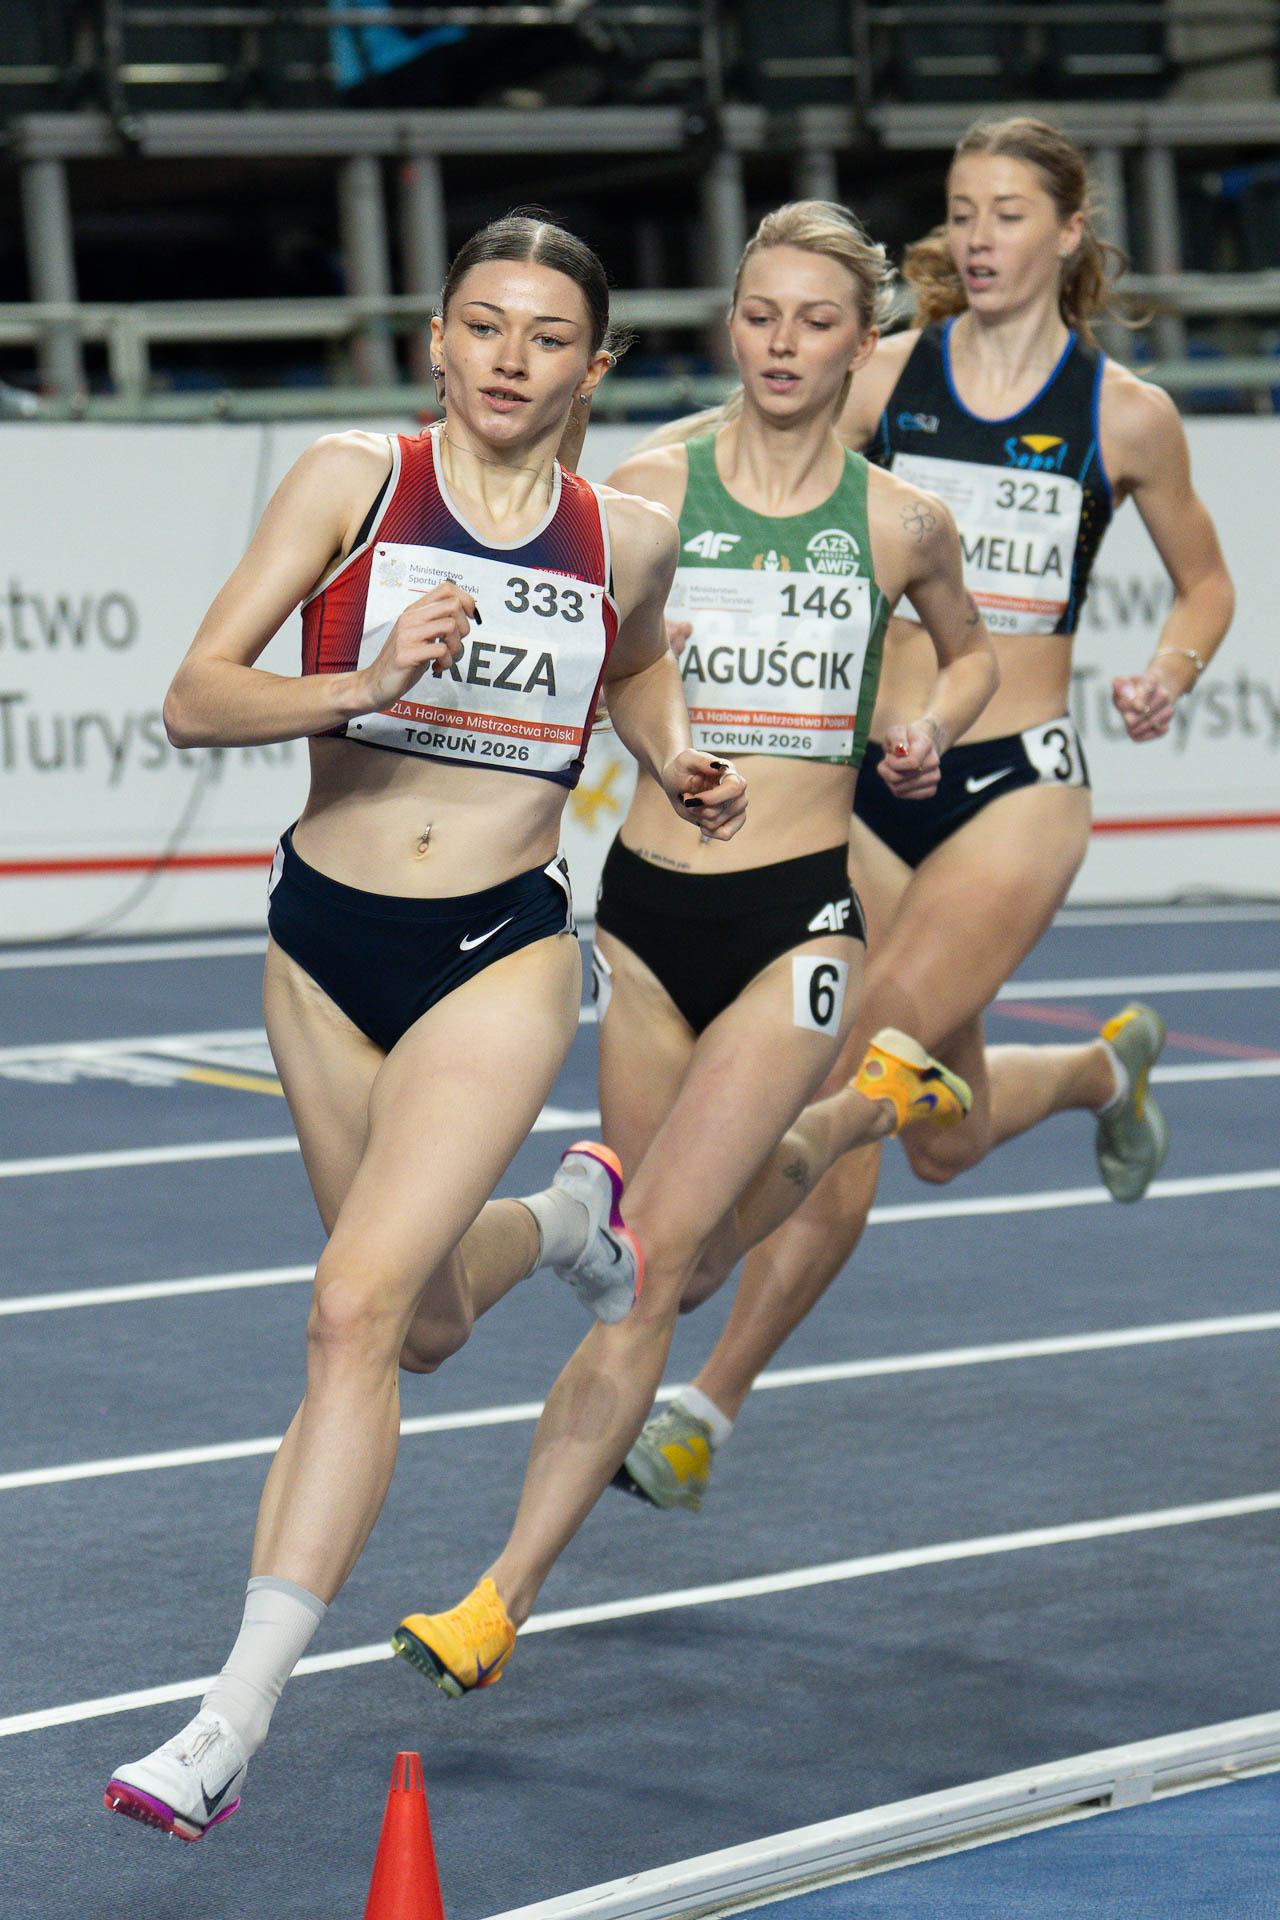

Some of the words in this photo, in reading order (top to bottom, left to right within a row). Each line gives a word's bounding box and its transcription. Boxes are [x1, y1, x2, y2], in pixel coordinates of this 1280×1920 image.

[996, 479, 1061, 515] 321
[684, 530, 742, 559] 4F
[815, 536, 849, 551] AZS
[960, 534, 1064, 578] MELLA
[408, 574, 436, 587] Sportu
[409, 564, 463, 580] Ministerstwo
[816, 558, 853, 574] AWF
[0, 577, 141, 653] two
[504, 577, 584, 623] 333
[780, 584, 852, 620] 146
[681, 641, 855, 690] AGUŚCIK
[415, 708, 463, 725] Halowe
[466, 717, 541, 737] Mistrzostwa
[544, 727, 575, 741] Polski
[707, 711, 750, 724] Halowe
[752, 714, 821, 728] Mistrzostwa
[405, 727, 477, 754] TORUŃ
[480, 741, 530, 761] 2026
[700, 730, 763, 746] TORUŃ
[768, 734, 812, 750] 2026
[1042, 727, 1073, 780] 3
[808, 899, 851, 932] 4F
[808, 964, 840, 1027] 6
